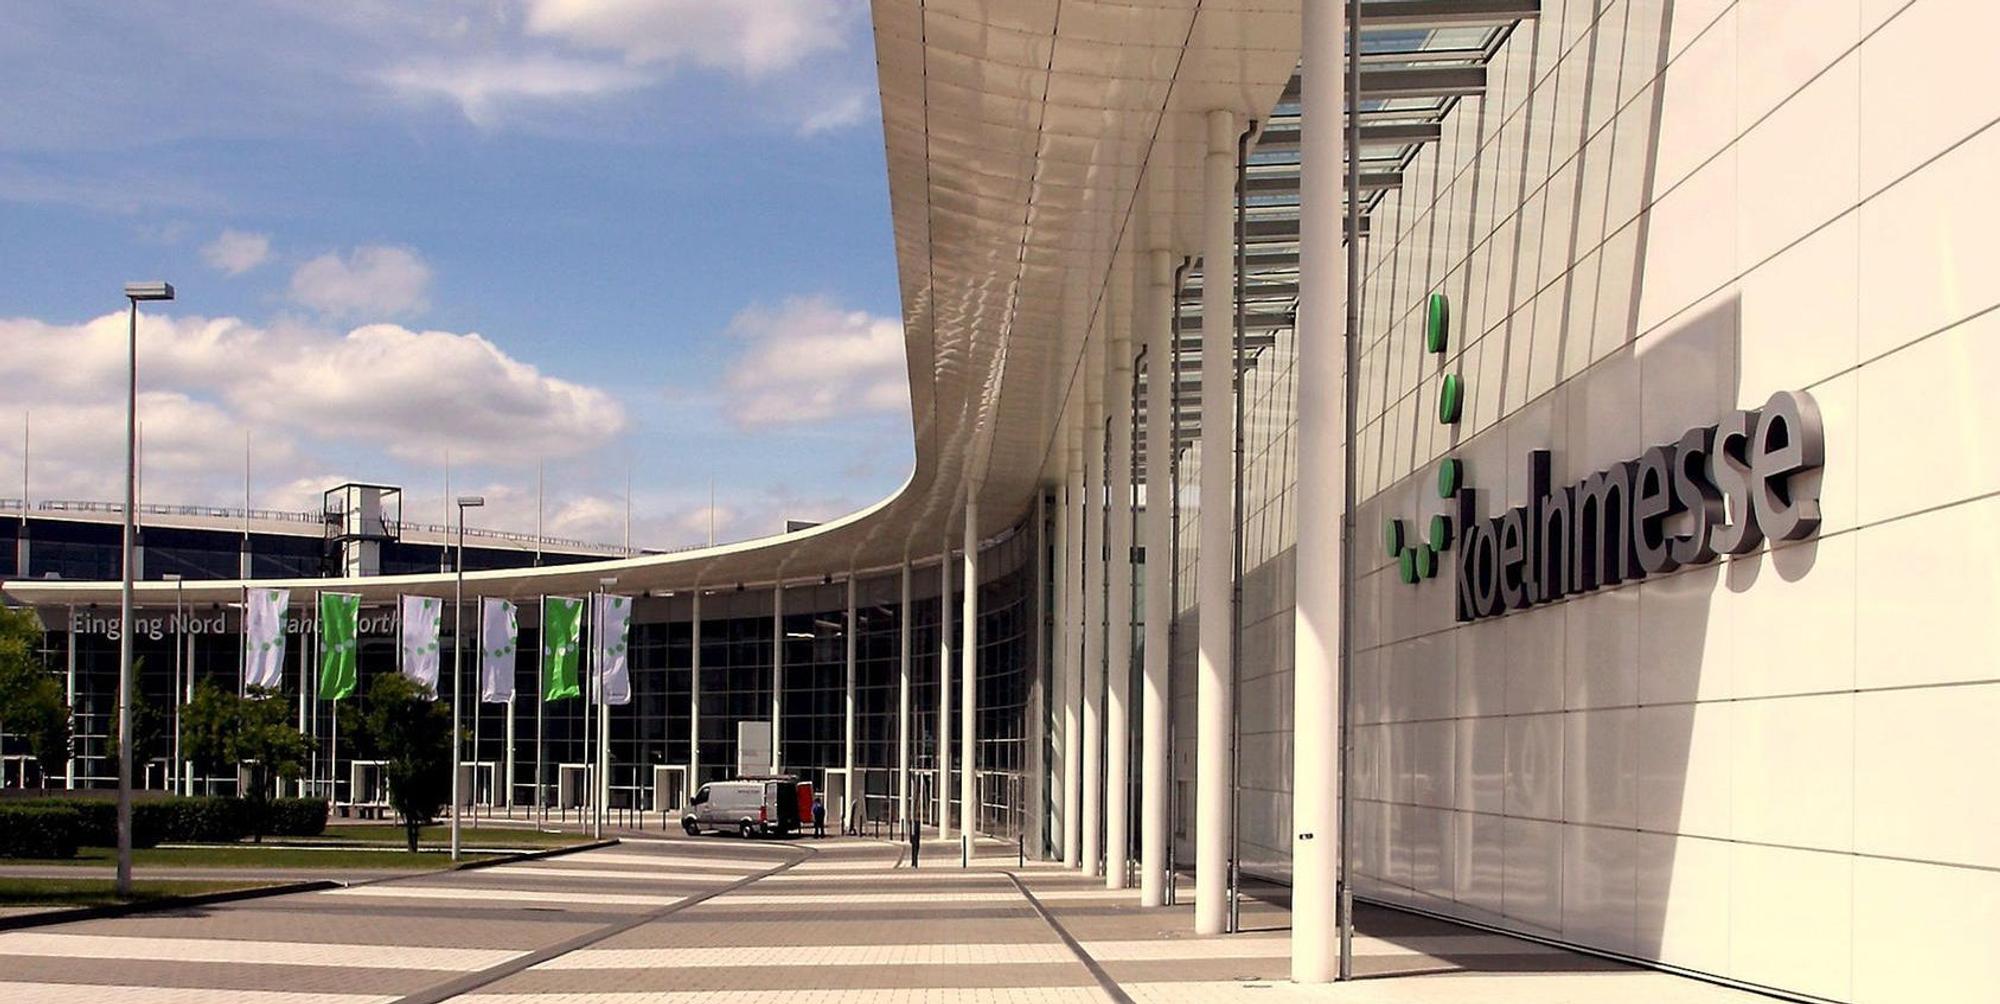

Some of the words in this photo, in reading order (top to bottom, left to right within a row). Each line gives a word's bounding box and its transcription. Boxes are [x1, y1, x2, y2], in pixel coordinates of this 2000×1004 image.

[1456, 390, 1824, 621] koelnmesse
[73, 612, 163, 640] Eingng
[170, 611, 225, 634] Nord
[358, 610, 400, 633] orth
